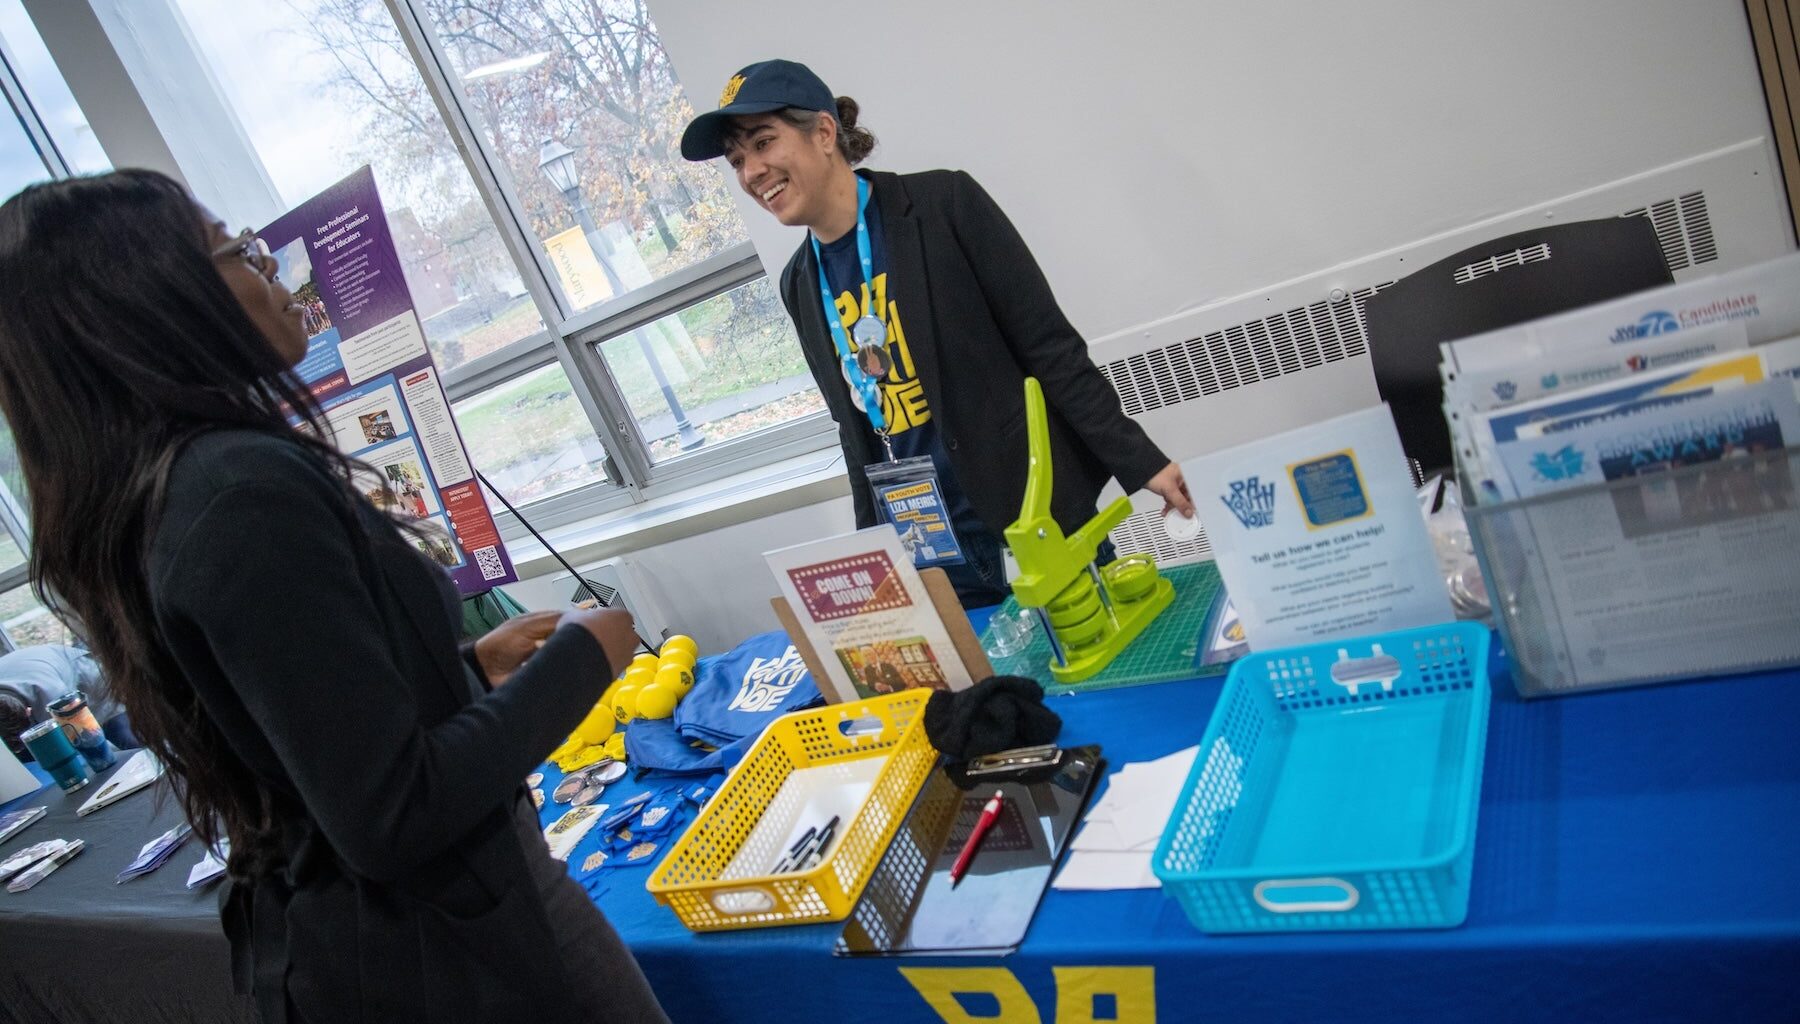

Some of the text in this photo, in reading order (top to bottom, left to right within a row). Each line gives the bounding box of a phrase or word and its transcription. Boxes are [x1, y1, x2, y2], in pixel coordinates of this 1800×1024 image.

[314, 214, 369, 250] Development Seminars
[317, 206, 359, 235] Free Professional
[328, 231, 360, 253] for Educators
[552, 242, 584, 302] Marywood
[1678, 294, 1758, 320] Candidate
[1631, 425, 1743, 466] AWARD
[1220, 482, 1274, 512] YOUTH
[1230, 476, 1258, 500] PA
[890, 500, 908, 514] LIZA
[1236, 510, 1274, 529] VOTE
[1252, 554, 1270, 564] Tell
[1289, 544, 1312, 554] how
[1316, 540, 1330, 548] we
[1334, 534, 1354, 544] can
[1356, 524, 1385, 539] help!
[816, 570, 874, 594] COME ON
[830, 585, 876, 606] DOWN!
[728, 681, 797, 712] VOTE
